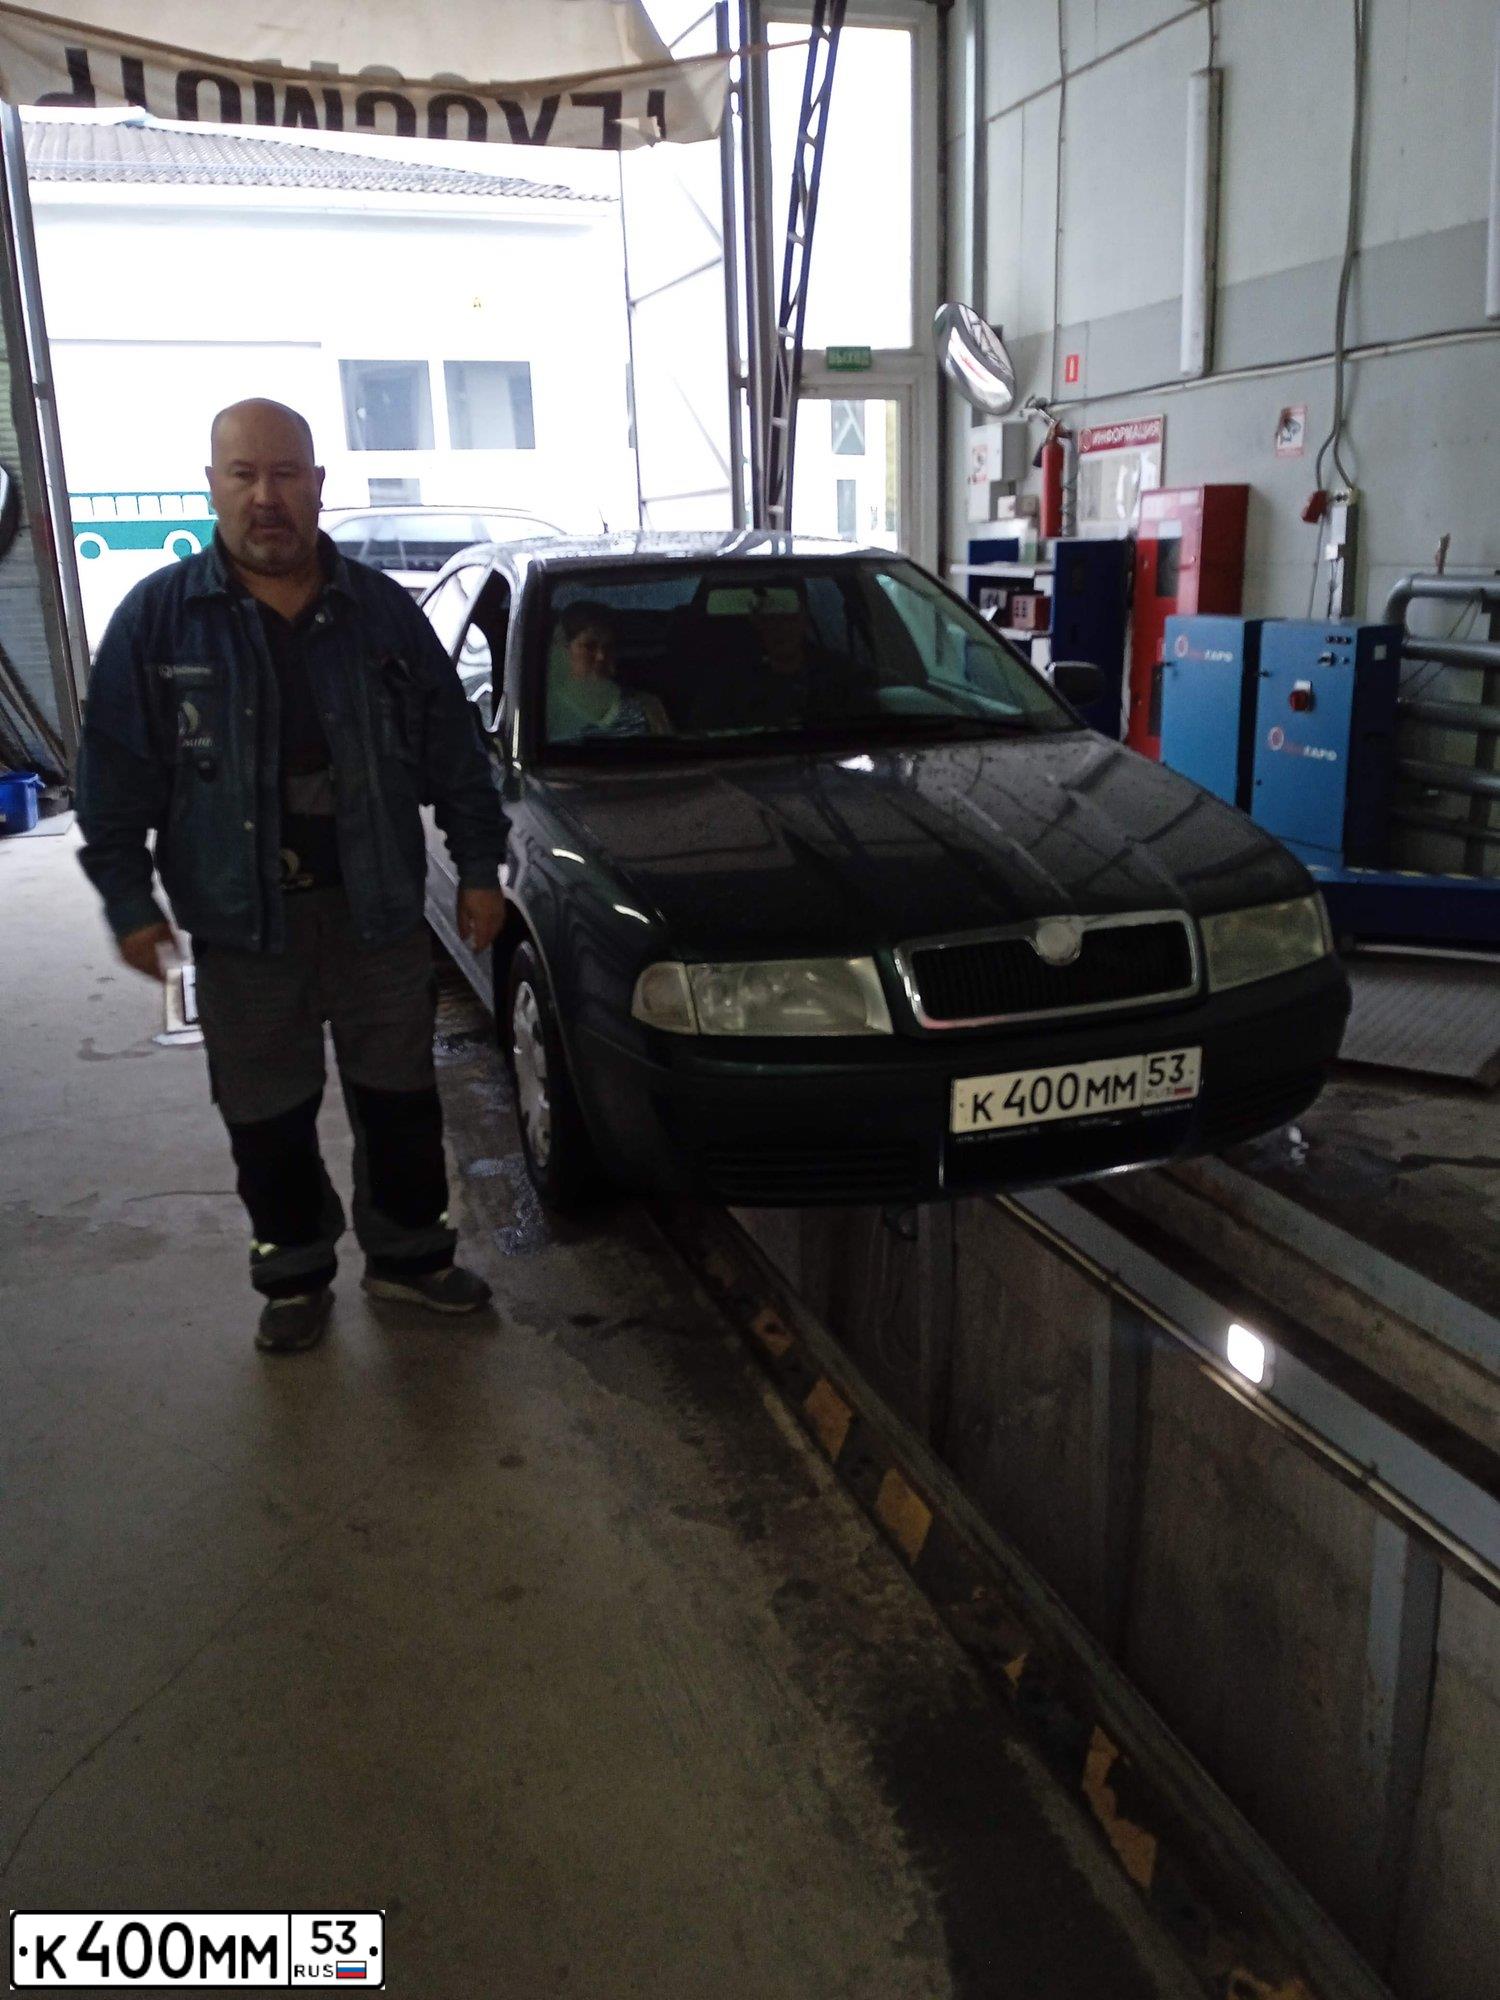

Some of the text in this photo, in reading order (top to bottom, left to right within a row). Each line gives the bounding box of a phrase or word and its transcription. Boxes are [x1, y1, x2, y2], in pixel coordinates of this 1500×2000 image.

[1093, 420, 1161, 445] ИНФОРМАЦИЯ
[971, 1053, 1187, 1124] К400ММ 53
